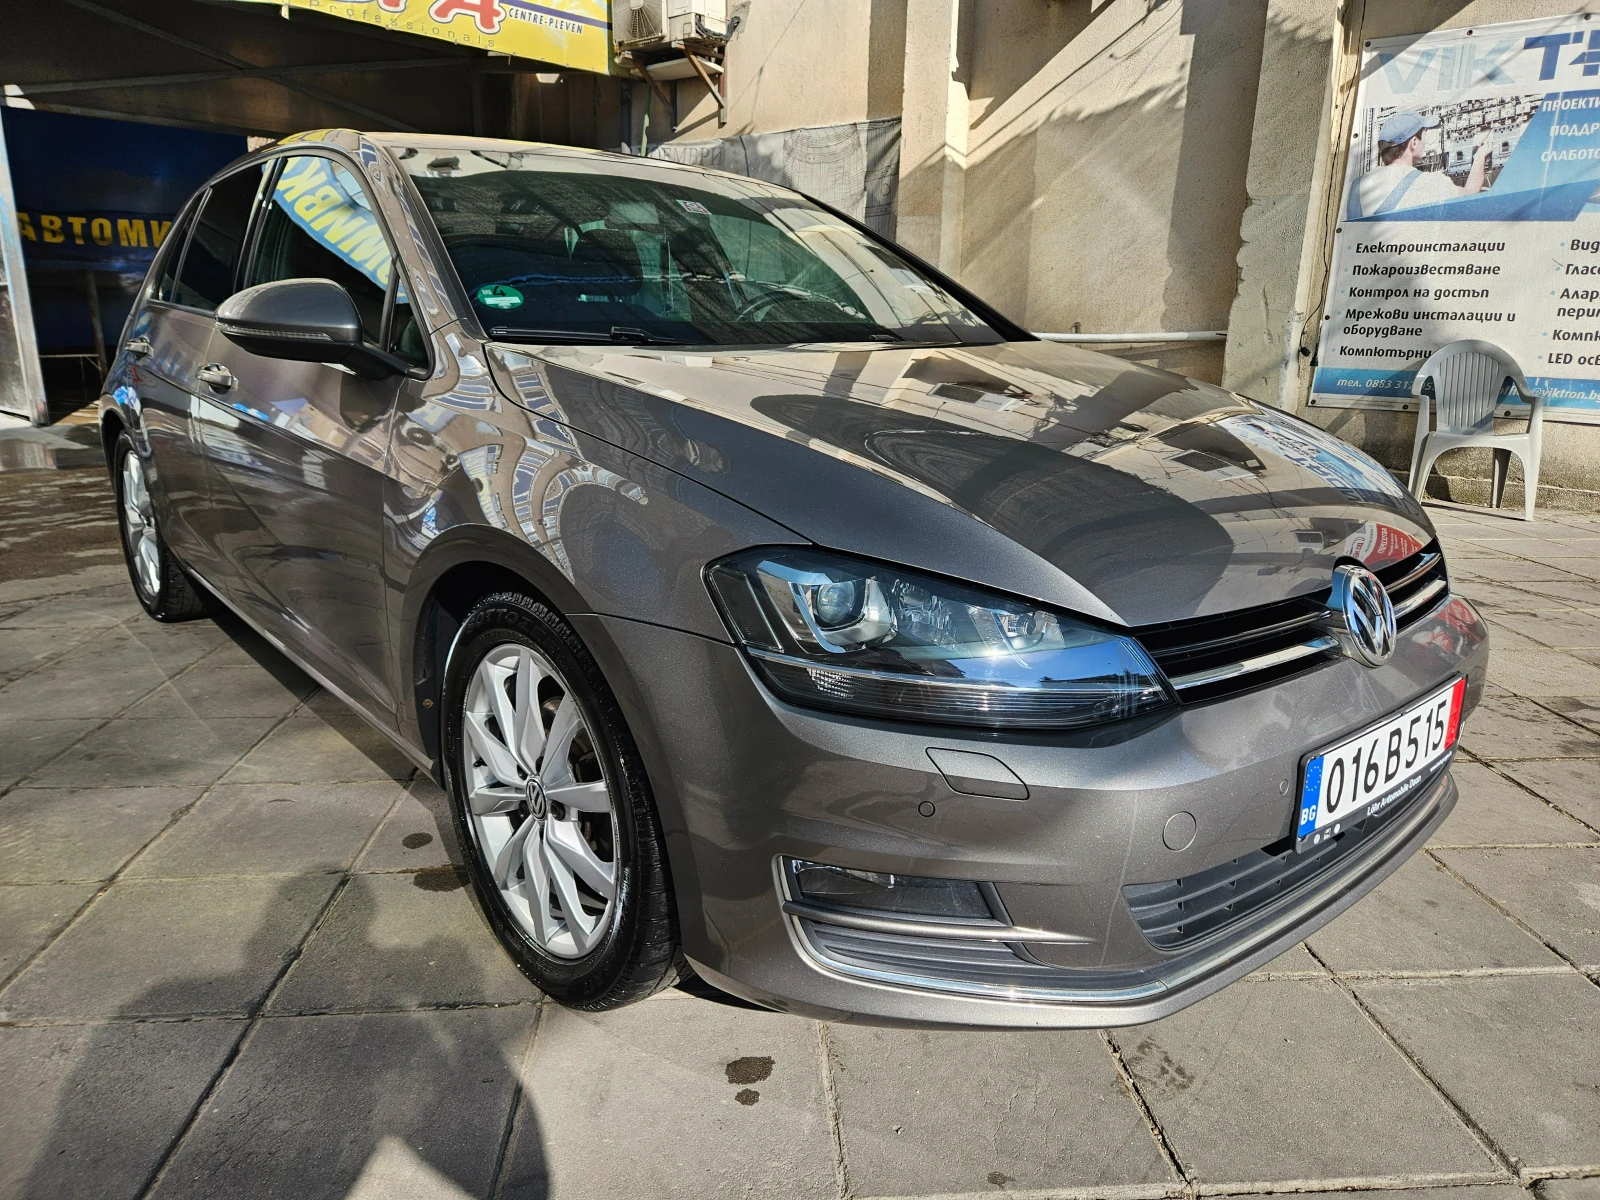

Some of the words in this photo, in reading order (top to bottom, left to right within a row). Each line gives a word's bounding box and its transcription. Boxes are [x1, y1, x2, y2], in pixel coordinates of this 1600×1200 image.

[508, 7, 583, 35] CENTRE-PLEVEN
[1355, 241, 1505, 256] Електроинсталации
[1352, 263, 1501, 278] Пожароизвестяване
[1349, 286, 1409, 300] Контрол
[1413, 288, 1430, 298] на
[1434, 287, 1490, 301] достъп
[1345, 308, 1409, 321] Мрежови
[1413, 311, 1502, 323] инсталации
[1506, 312, 1516, 322] и
[1343, 324, 1423, 338] оборудване
[1339, 345, 1432, 360] Компютърни
[1547, 352, 1573, 365] LED
[1365, 379, 1393, 389] 0883
[1326, 699, 1447, 814] 016B515
[1301, 804, 1317, 826] BG
